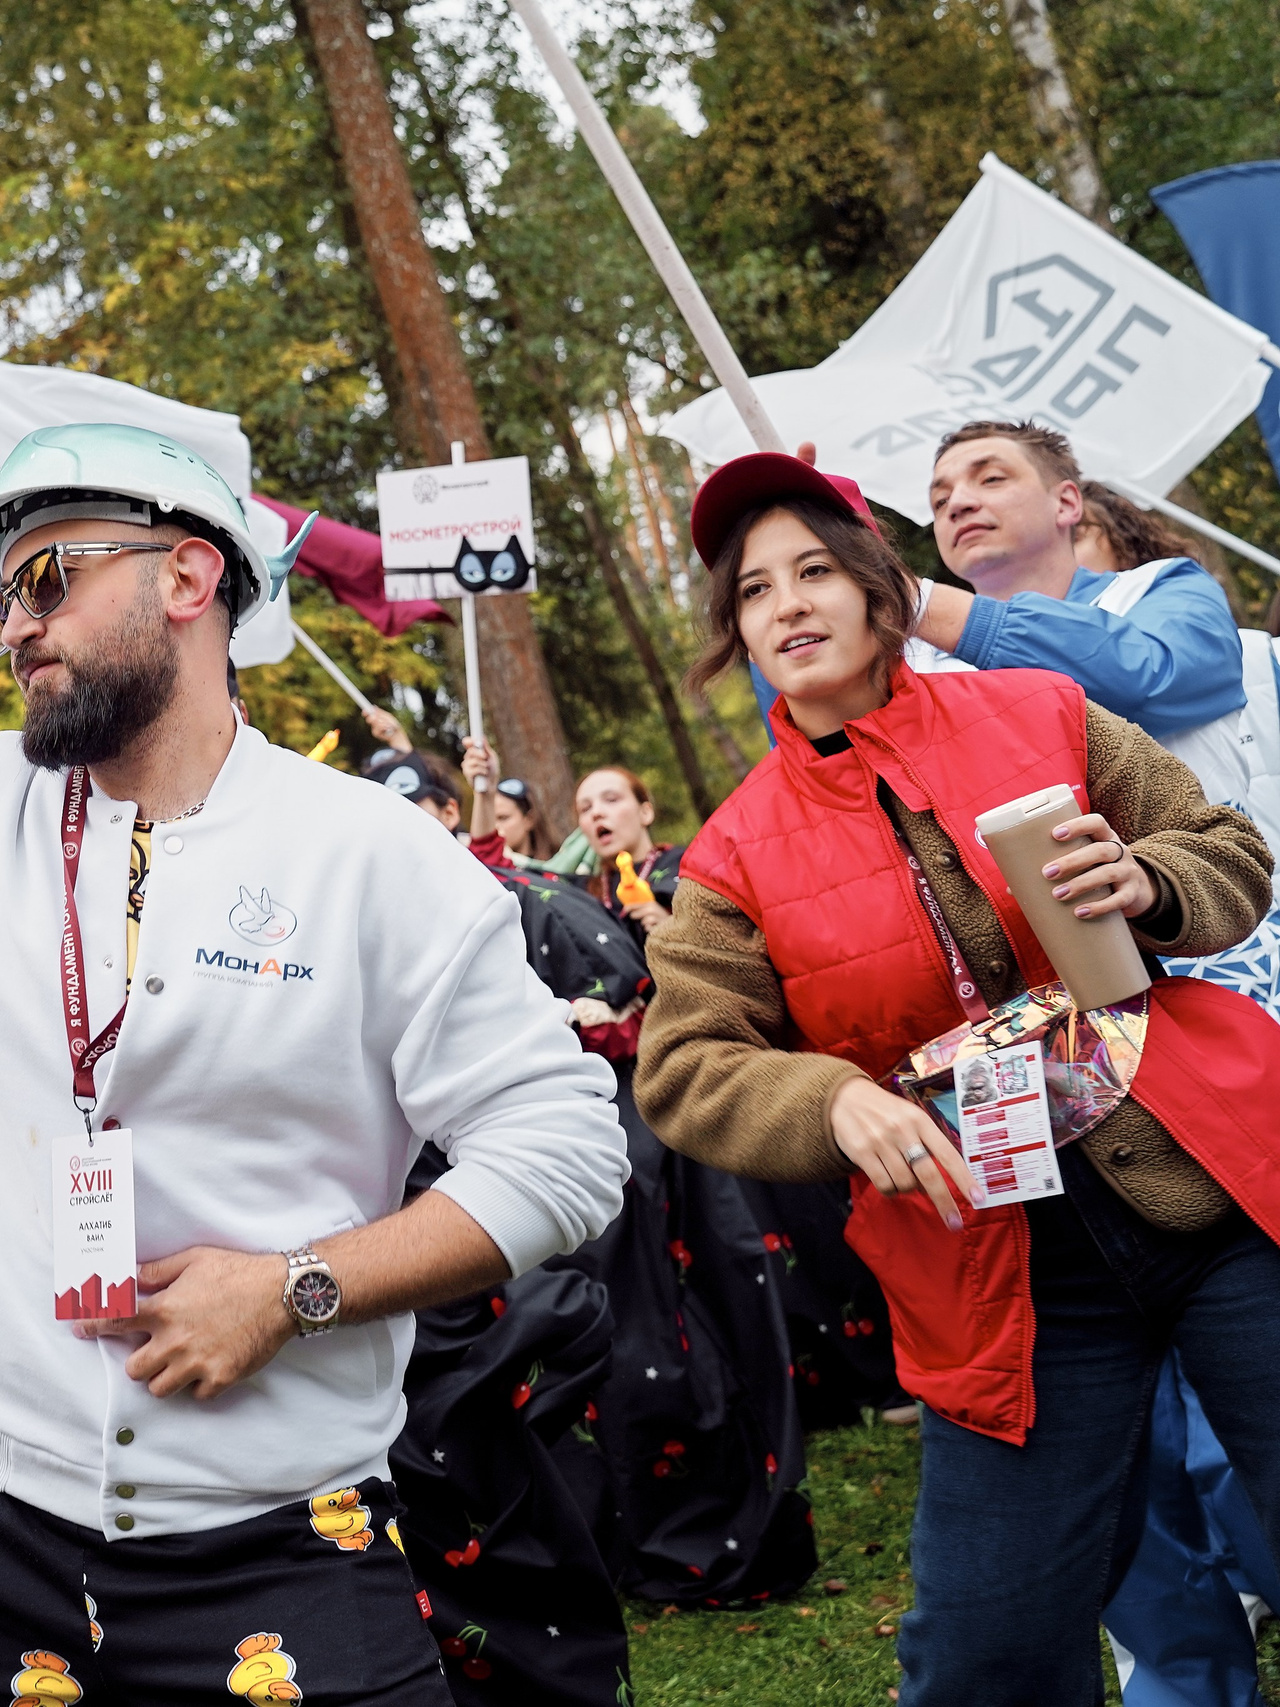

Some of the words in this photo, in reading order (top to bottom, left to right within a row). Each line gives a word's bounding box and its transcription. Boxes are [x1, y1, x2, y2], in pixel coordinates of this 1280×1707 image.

[389, 516, 522, 541] МОСМЕТРОСТРОЙ
[67, 825, 78, 833] Я
[64, 929, 81, 1015] ФУНДАМЕНТ
[195, 948, 314, 981] МонАрх
[70, 1018, 81, 1027] Я
[70, 1169, 112, 1194] XVIII
[79, 1220, 112, 1231] АЛХАТИБ
